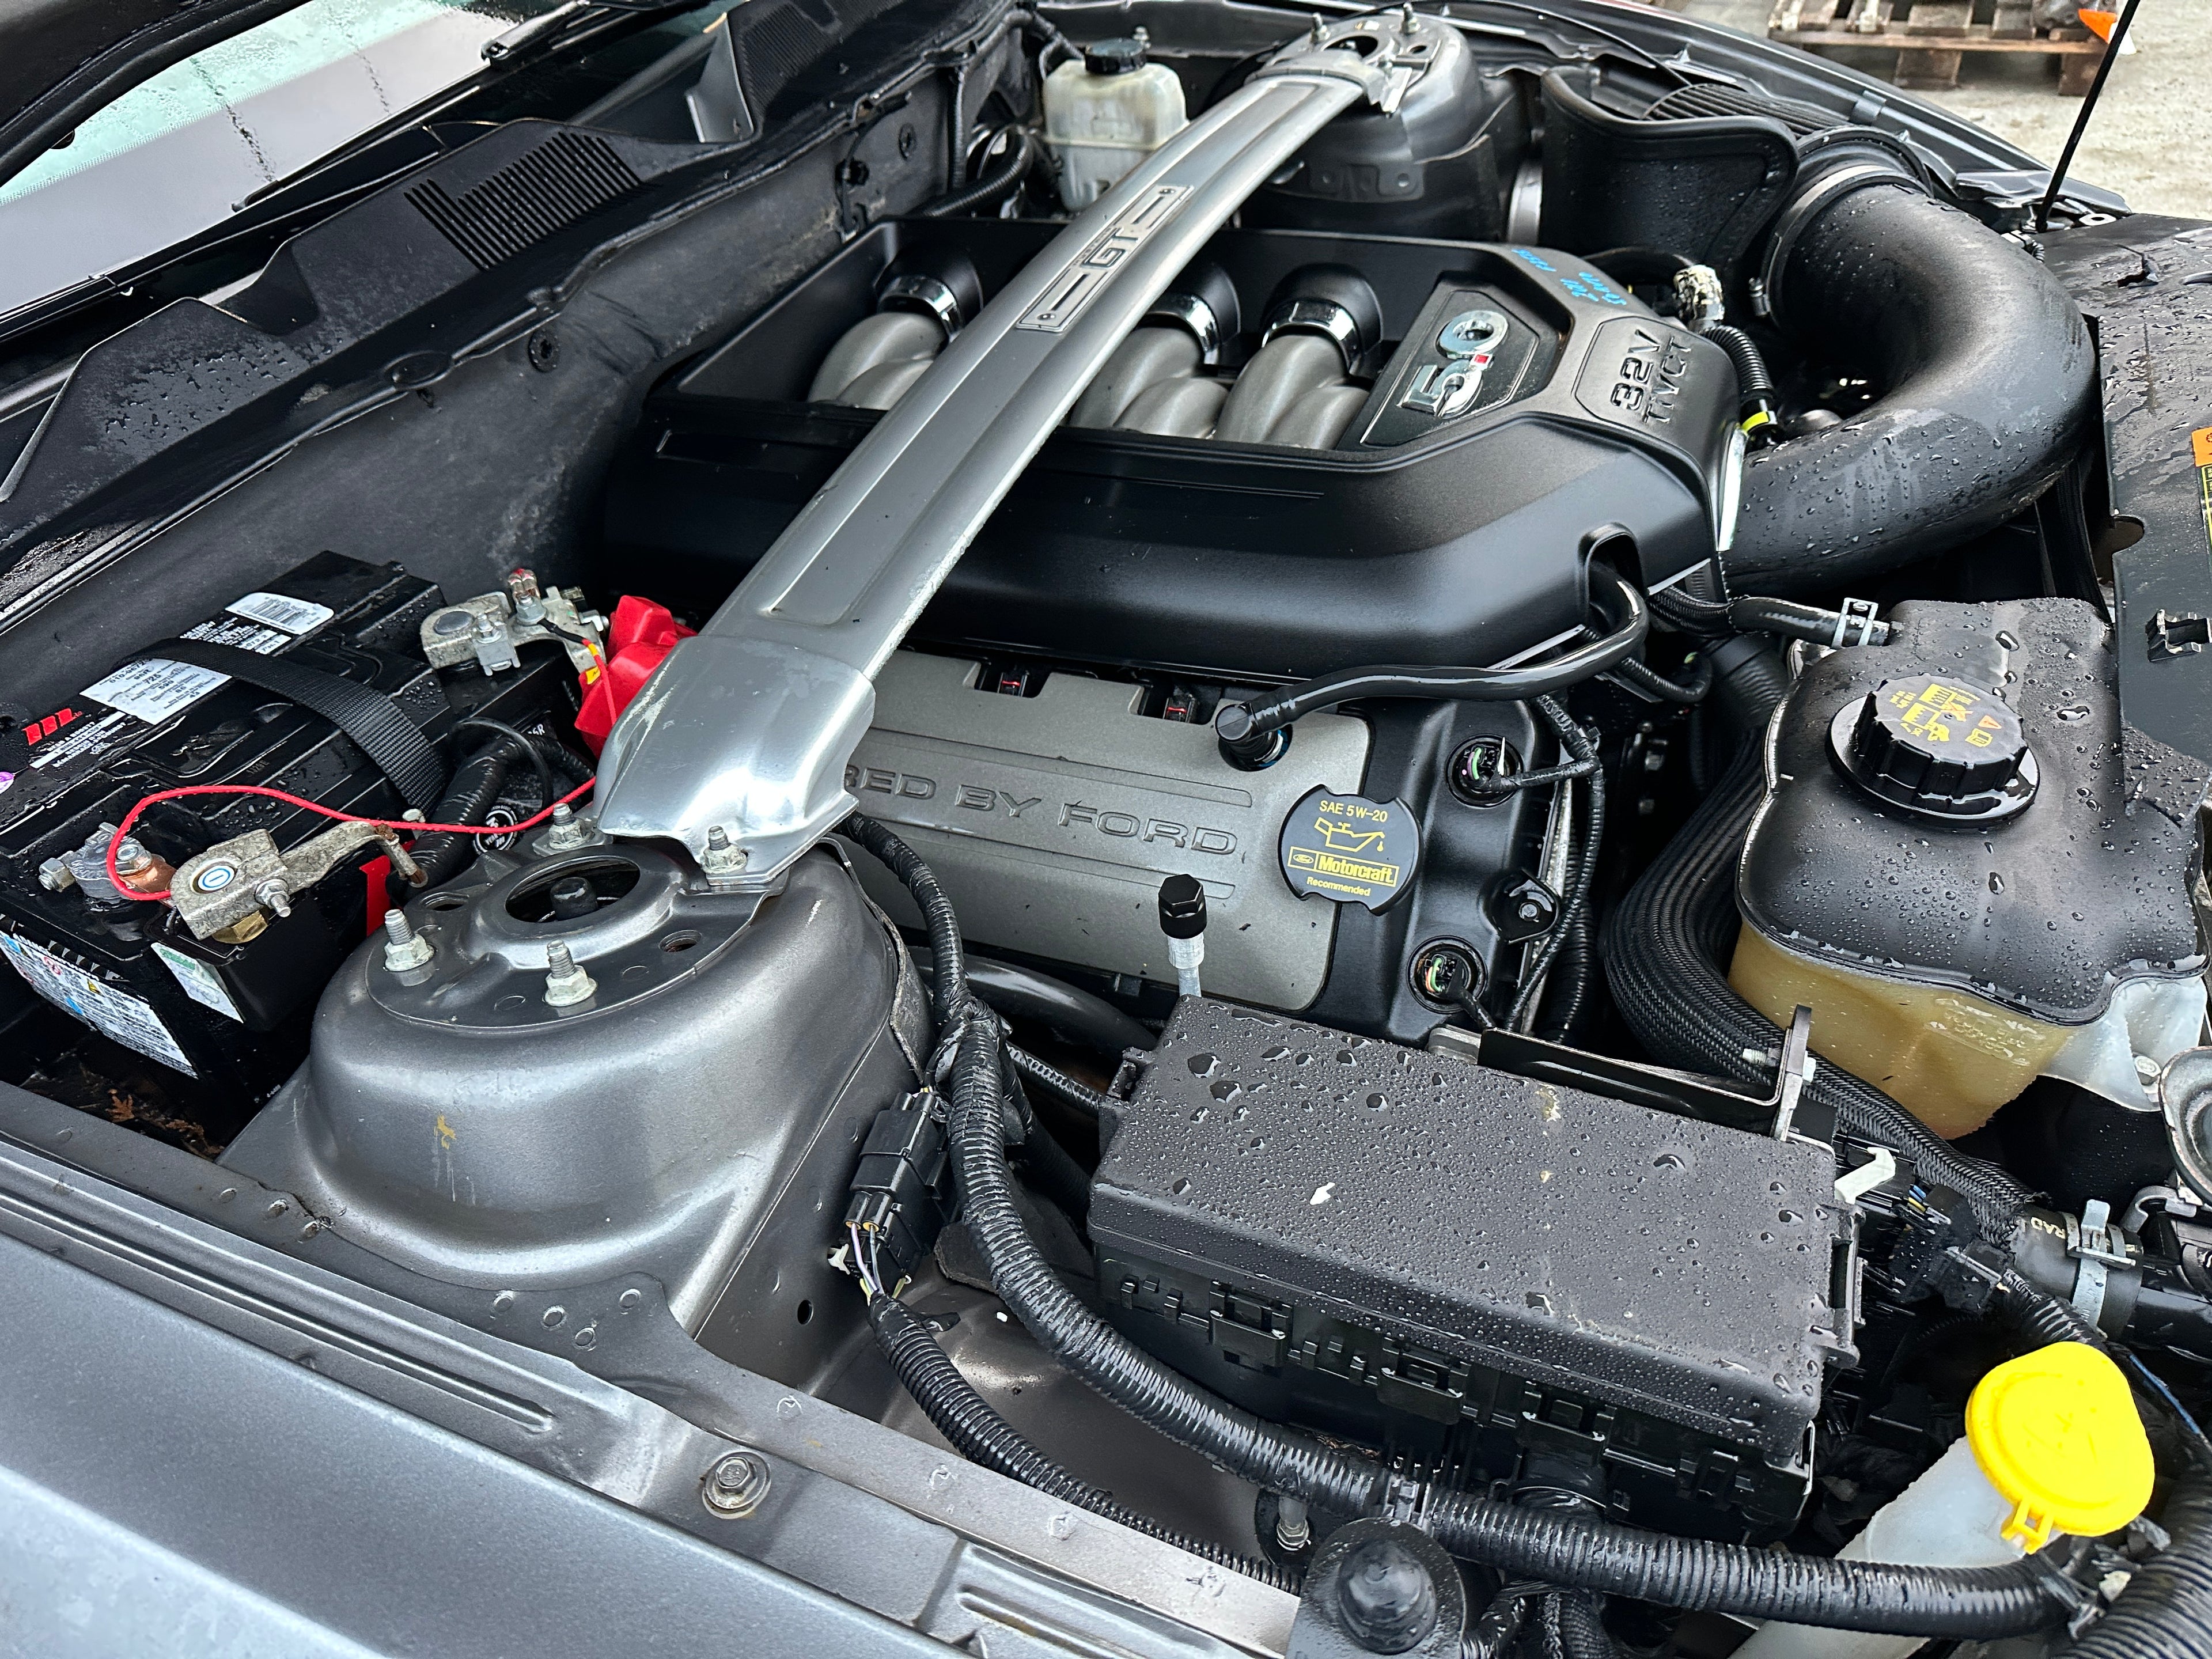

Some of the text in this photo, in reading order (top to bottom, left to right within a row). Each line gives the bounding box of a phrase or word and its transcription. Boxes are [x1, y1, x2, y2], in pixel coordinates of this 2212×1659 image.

[1080, 226, 1141, 267] GT
[1610, 329, 1661, 411] 32V
[955, 784, 1042, 818] BY
[1058, 802, 1238, 855] FORD
[1319, 800, 1388, 823] SAE 5W-20
[1306, 876, 1371, 897] Recommended
